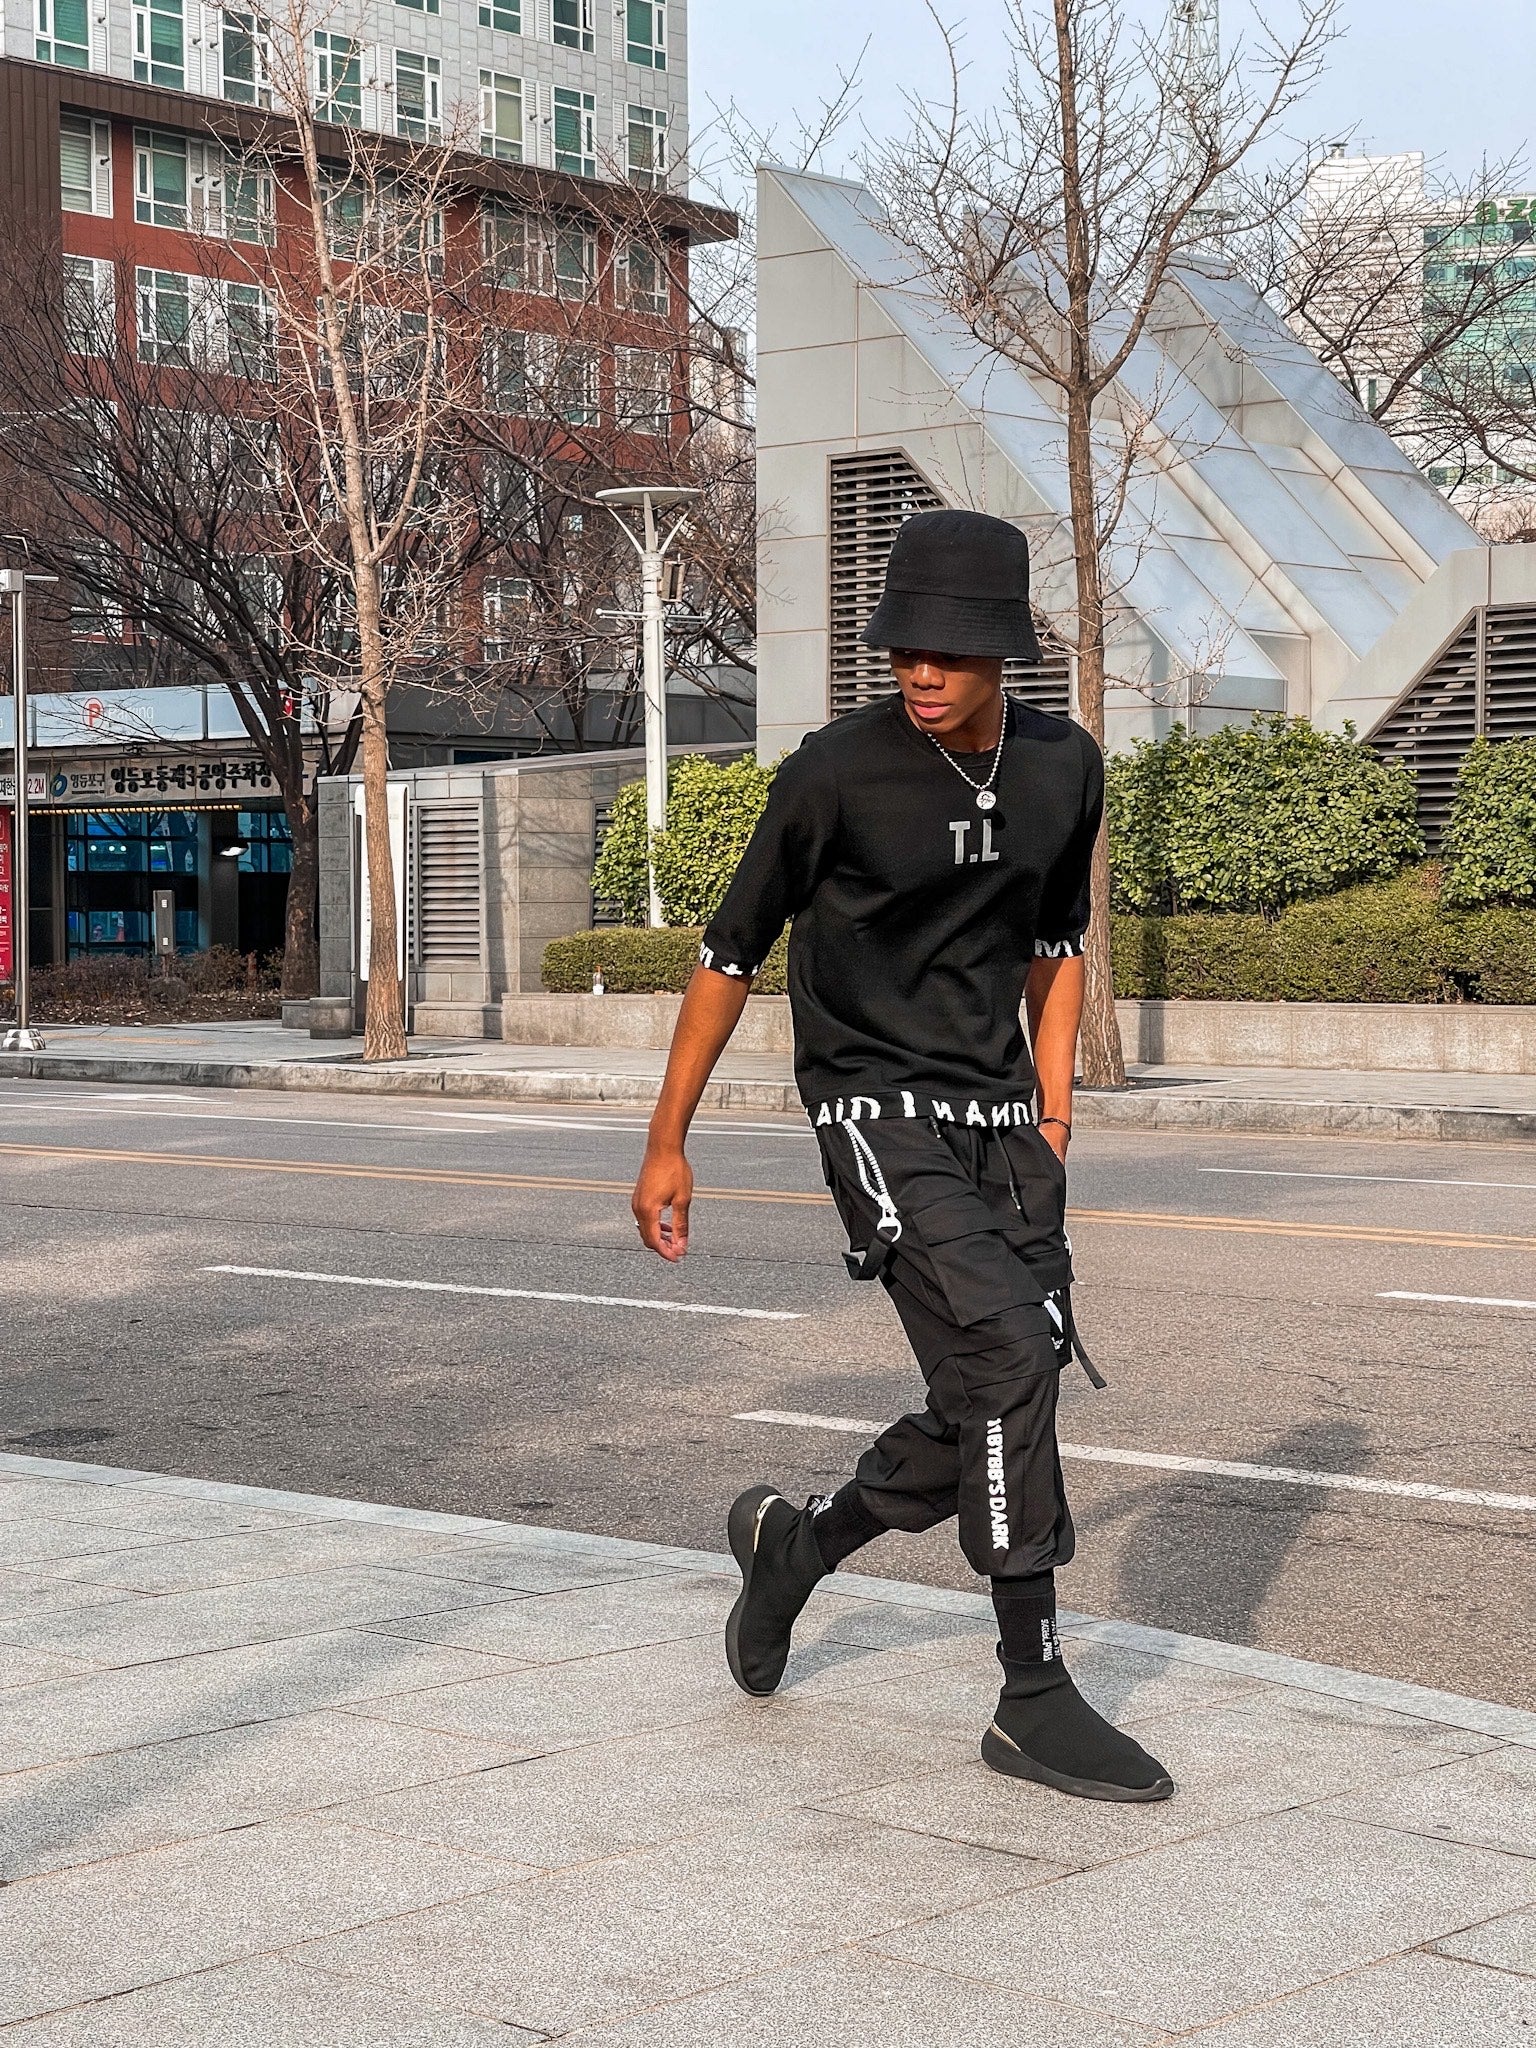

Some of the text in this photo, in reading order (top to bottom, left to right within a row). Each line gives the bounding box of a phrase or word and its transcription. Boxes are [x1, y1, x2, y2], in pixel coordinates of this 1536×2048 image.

[70, 773, 105, 789] 영등포구
[949, 819, 999, 864] T.L
[989, 1496, 1010, 1550] DARK
